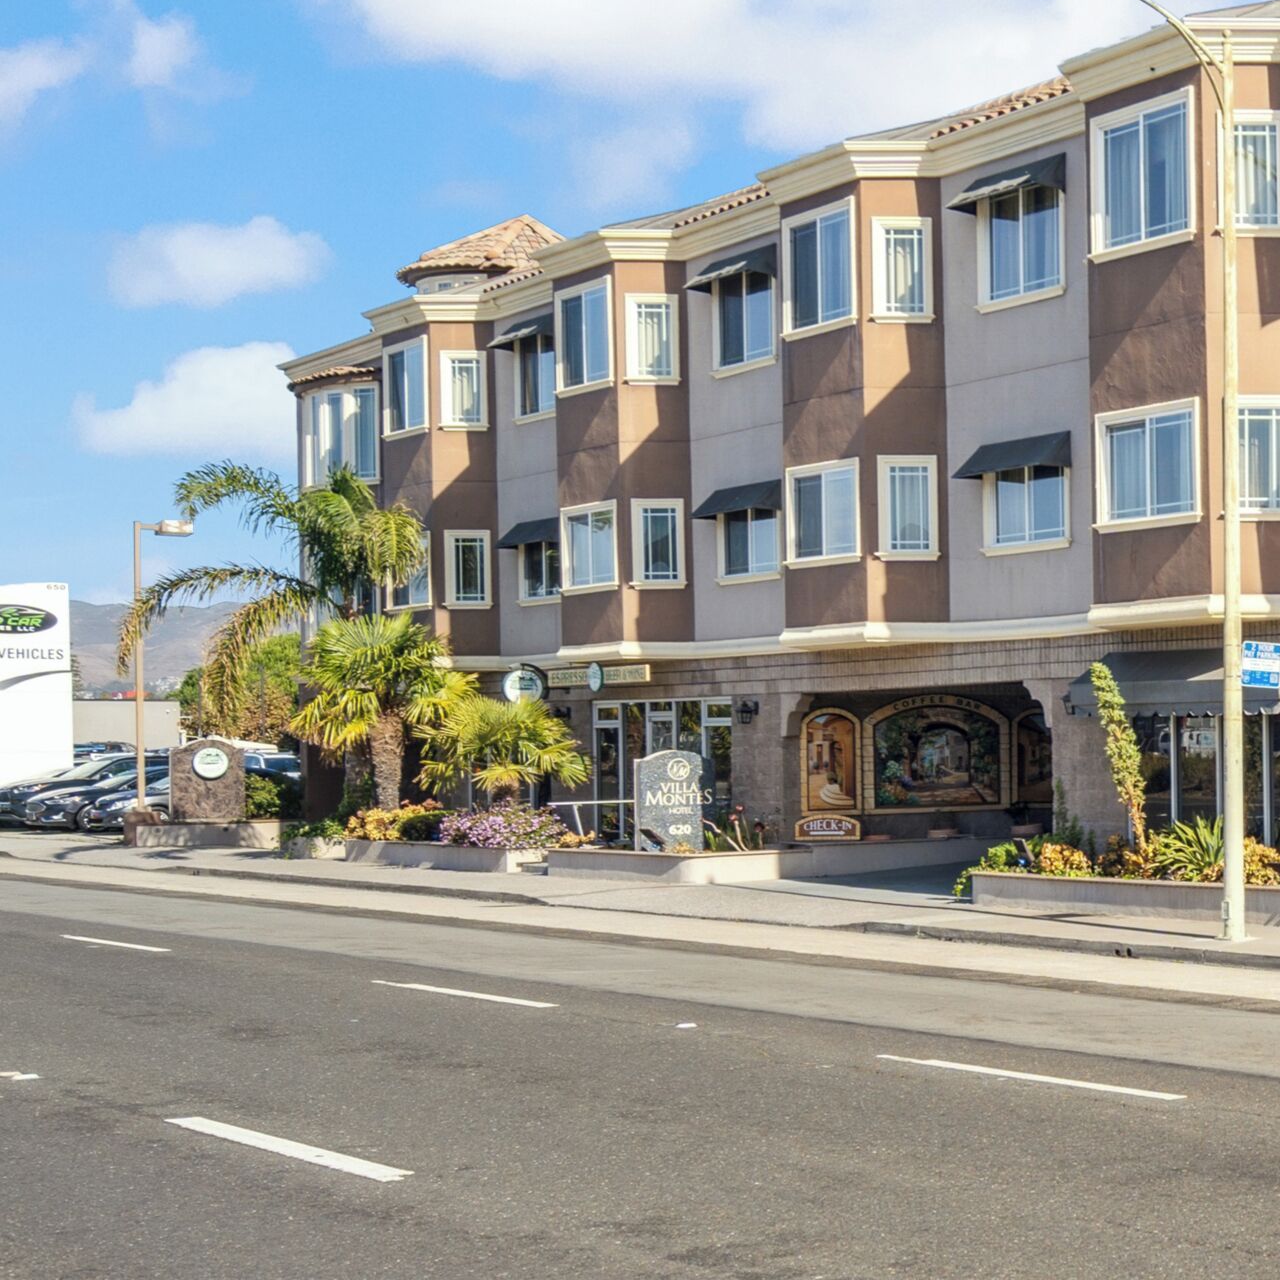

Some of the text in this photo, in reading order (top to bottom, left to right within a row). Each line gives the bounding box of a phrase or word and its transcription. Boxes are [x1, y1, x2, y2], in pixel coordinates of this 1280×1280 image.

[7, 617, 42, 627] CAR
[0, 648, 64, 660] VEHICLES
[893, 696, 980, 711] COFFEE BAR
[660, 782, 698, 793] VILLA
[645, 789, 713, 806] MONTES
[669, 807, 694, 815] HOTEL
[668, 824, 692, 835] 620
[803, 819, 852, 830] CHECK-IN
